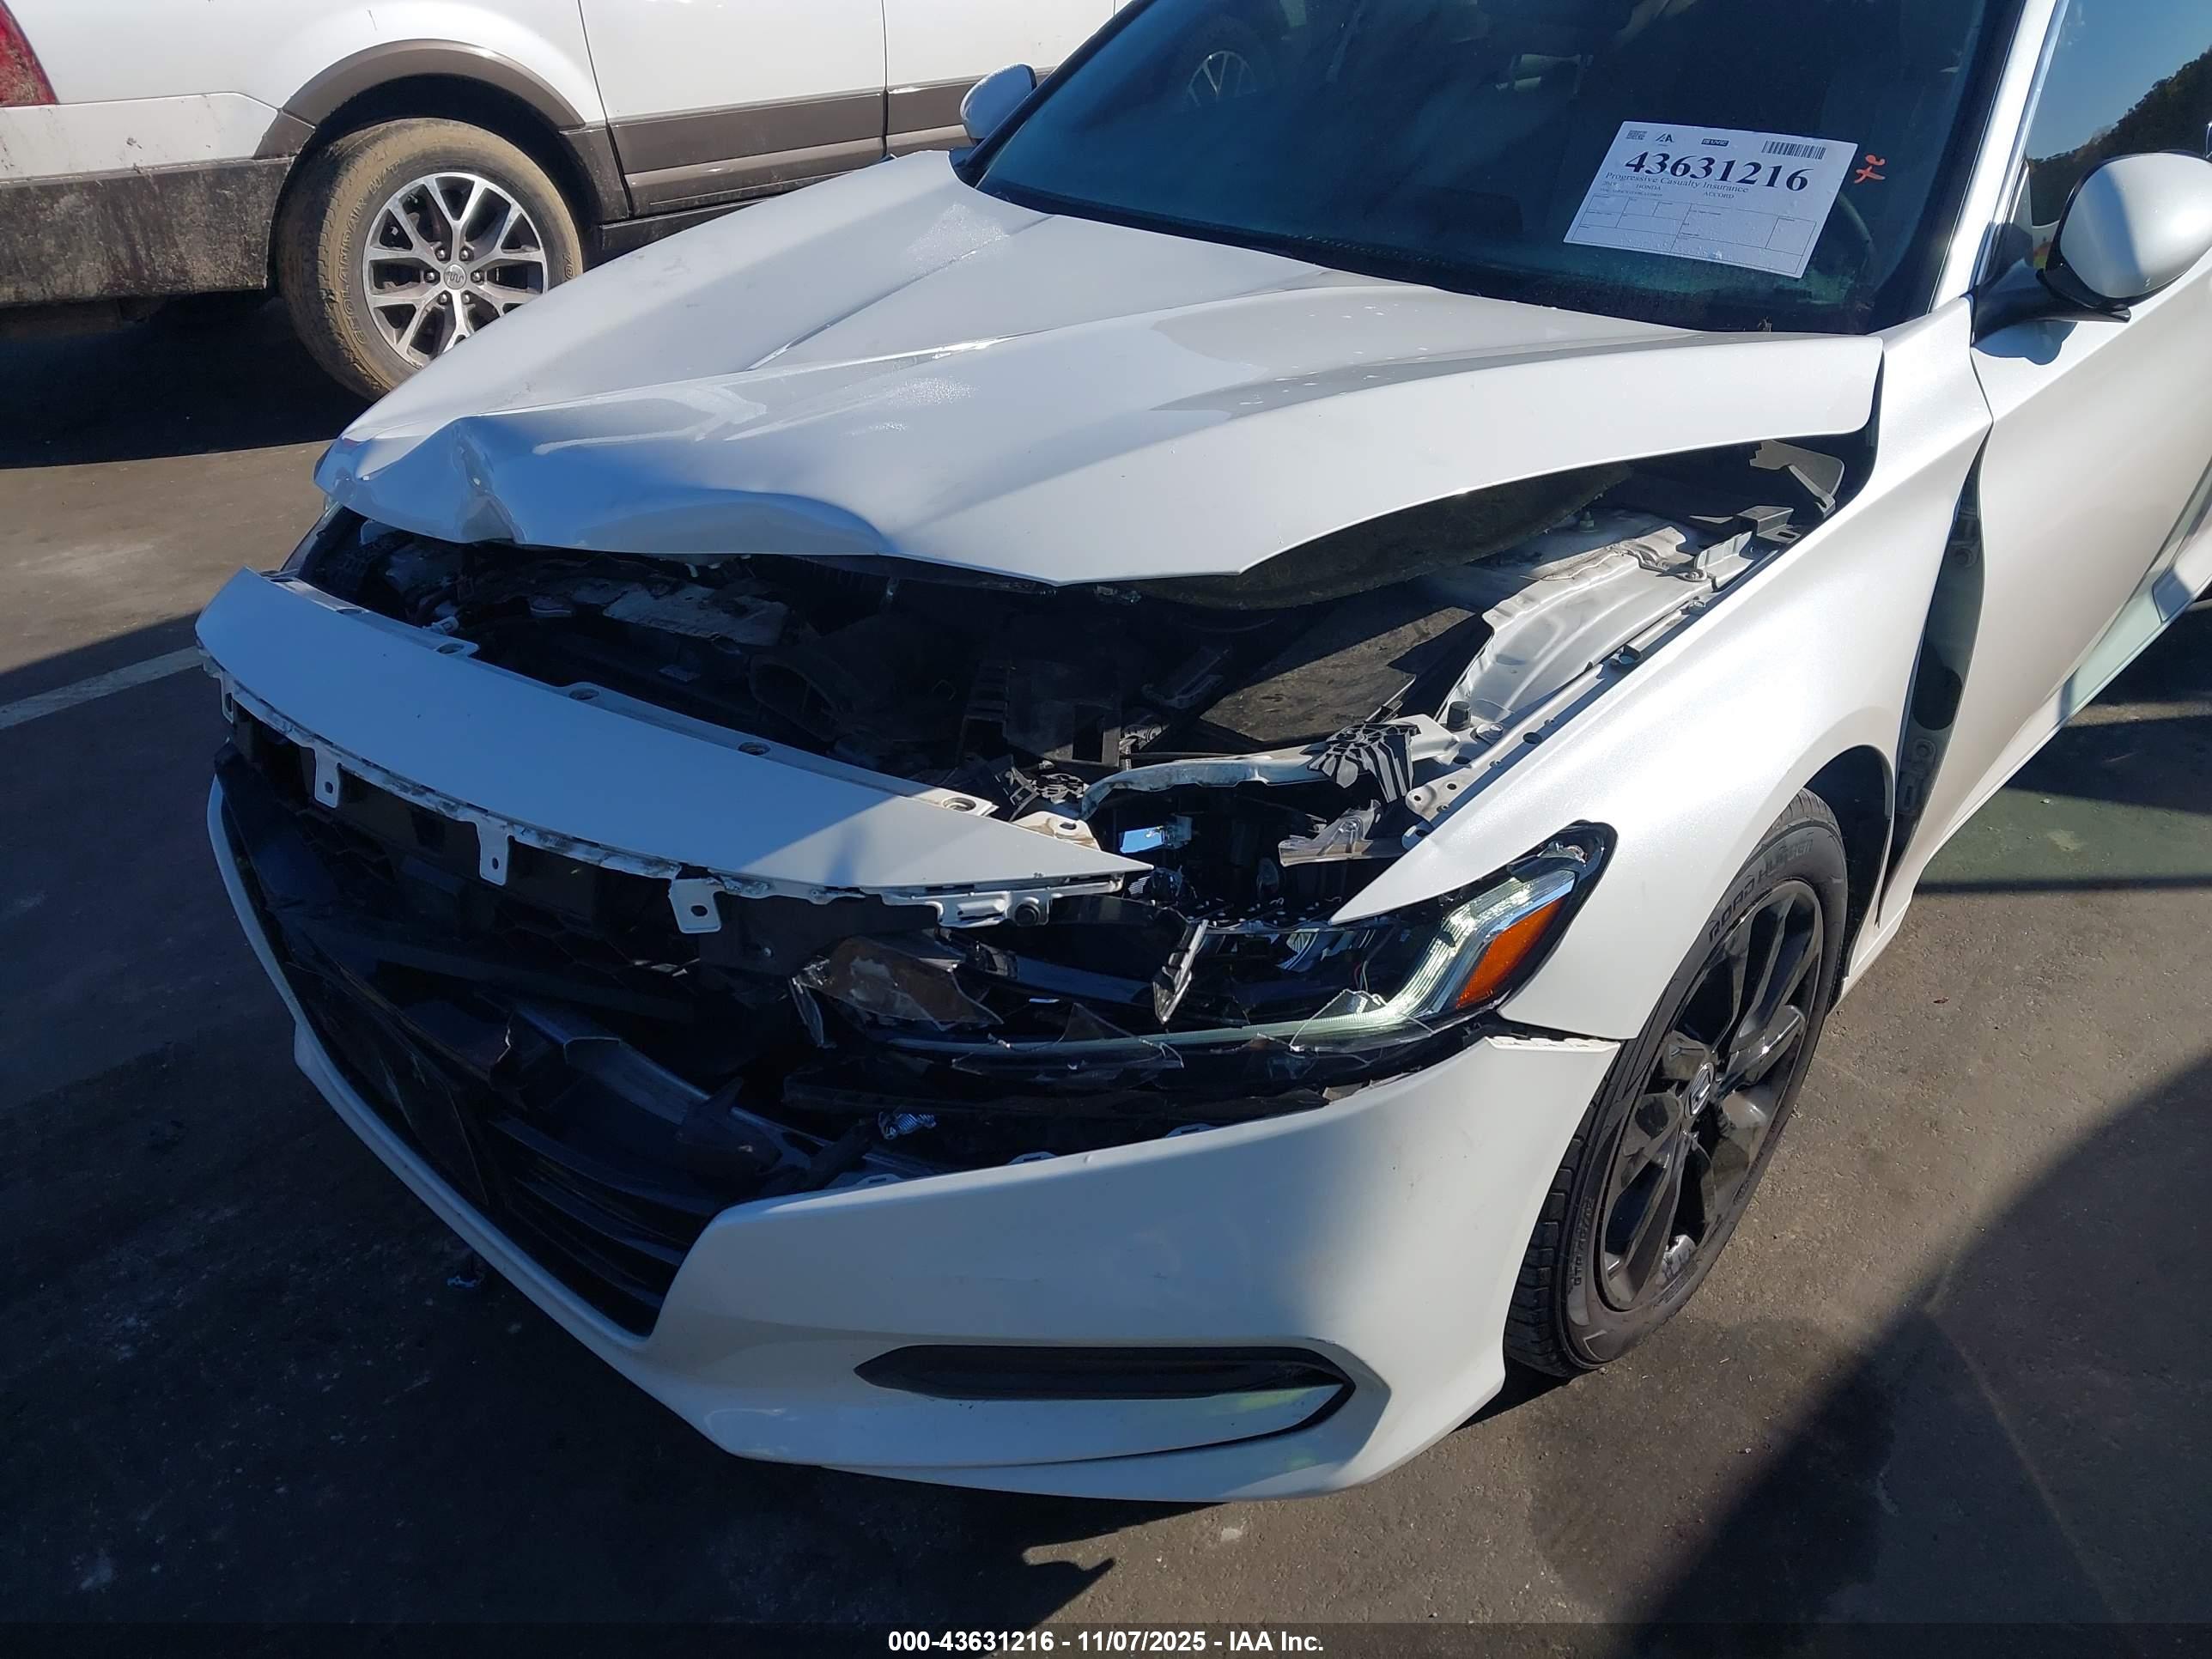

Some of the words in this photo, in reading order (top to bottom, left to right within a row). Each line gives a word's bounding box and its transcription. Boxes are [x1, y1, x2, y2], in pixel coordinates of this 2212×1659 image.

[1605, 172, 1659, 184] Progressive
[1659, 177, 1701, 189] Casualty
[1702, 182, 1750, 194] Insurance
[1626, 150, 1814, 192] 43631216
